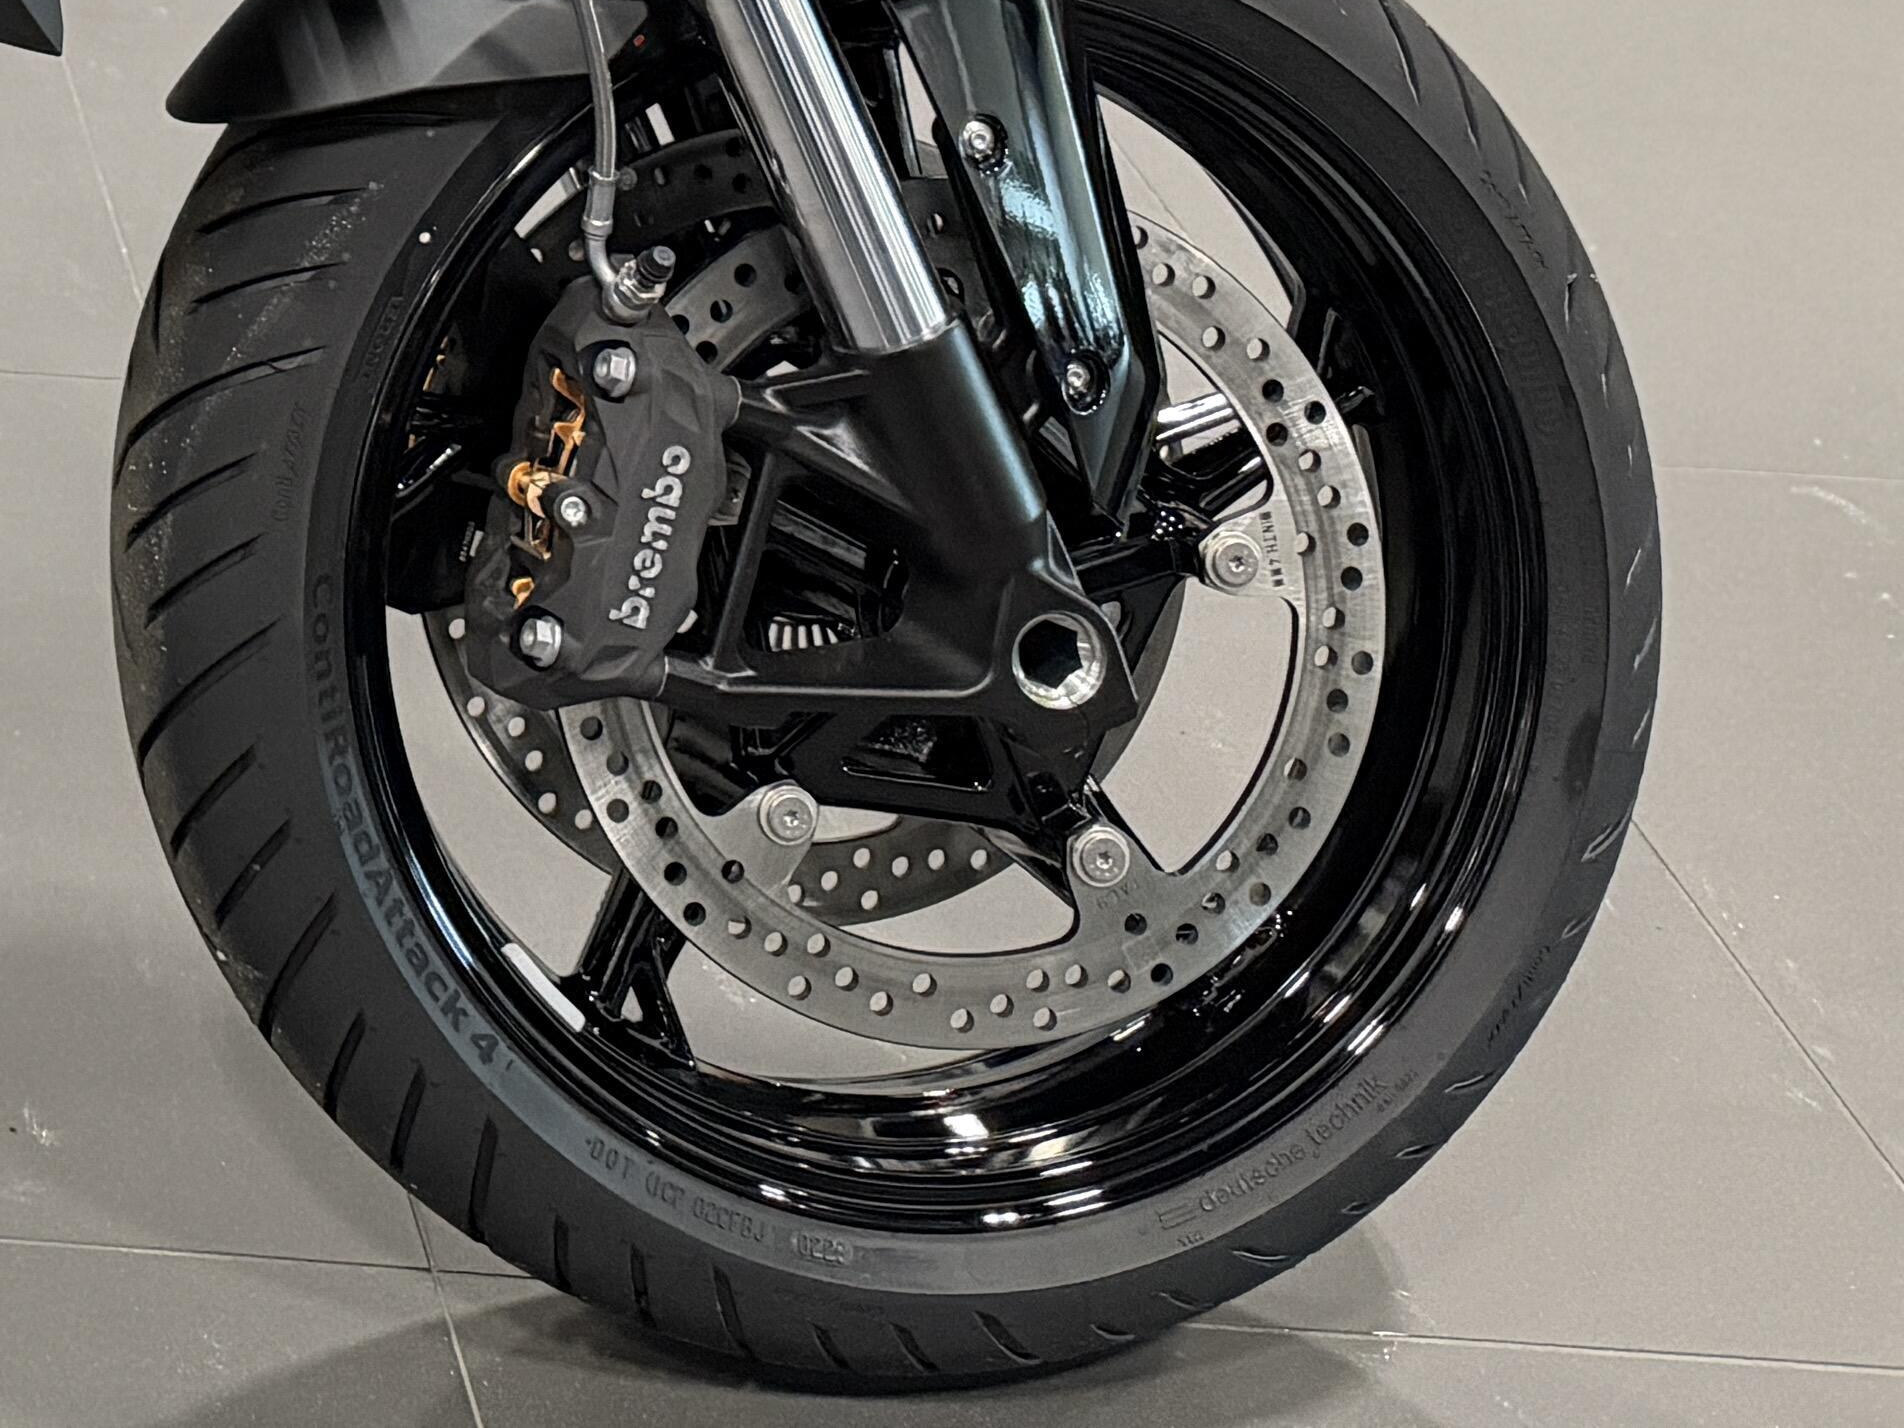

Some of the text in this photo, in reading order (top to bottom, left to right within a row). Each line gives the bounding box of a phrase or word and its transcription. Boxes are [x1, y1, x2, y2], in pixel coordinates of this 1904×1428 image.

[608, 444, 691, 630] brembo
[310, 573, 502, 1069] ContiRoadAttack 4
